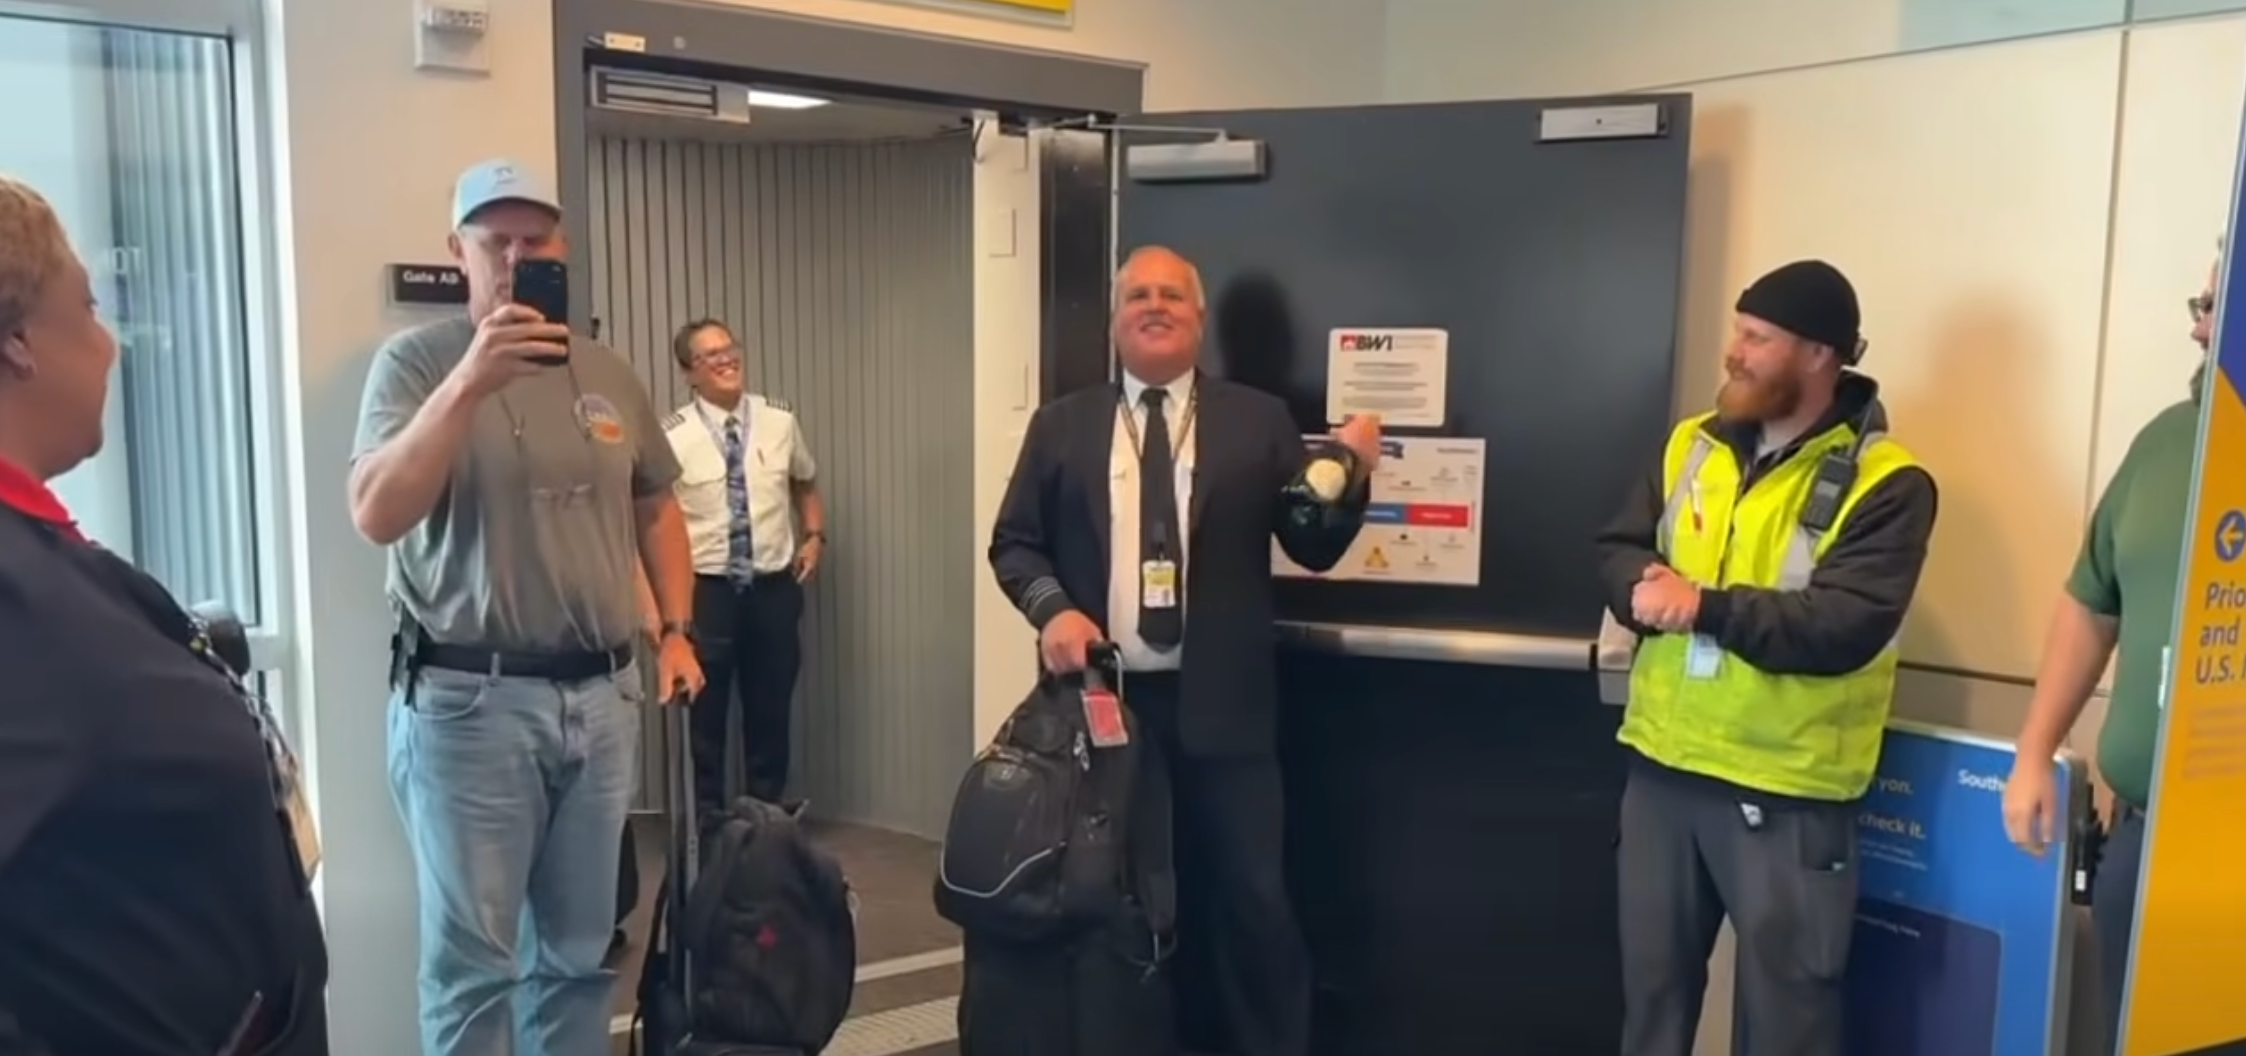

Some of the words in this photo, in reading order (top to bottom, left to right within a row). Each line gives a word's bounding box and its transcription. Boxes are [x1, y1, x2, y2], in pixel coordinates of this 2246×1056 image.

[402, 269, 435, 284] Gate
[1356, 334, 1392, 351] BWI
[2204, 579, 2246, 611] Prio
[2199, 614, 2241, 648] and
[2196, 655, 2235, 684] U.S.
[1957, 768, 2006, 792] South
[1857, 813, 1906, 835] check
[1909, 820, 1927, 840] it.
